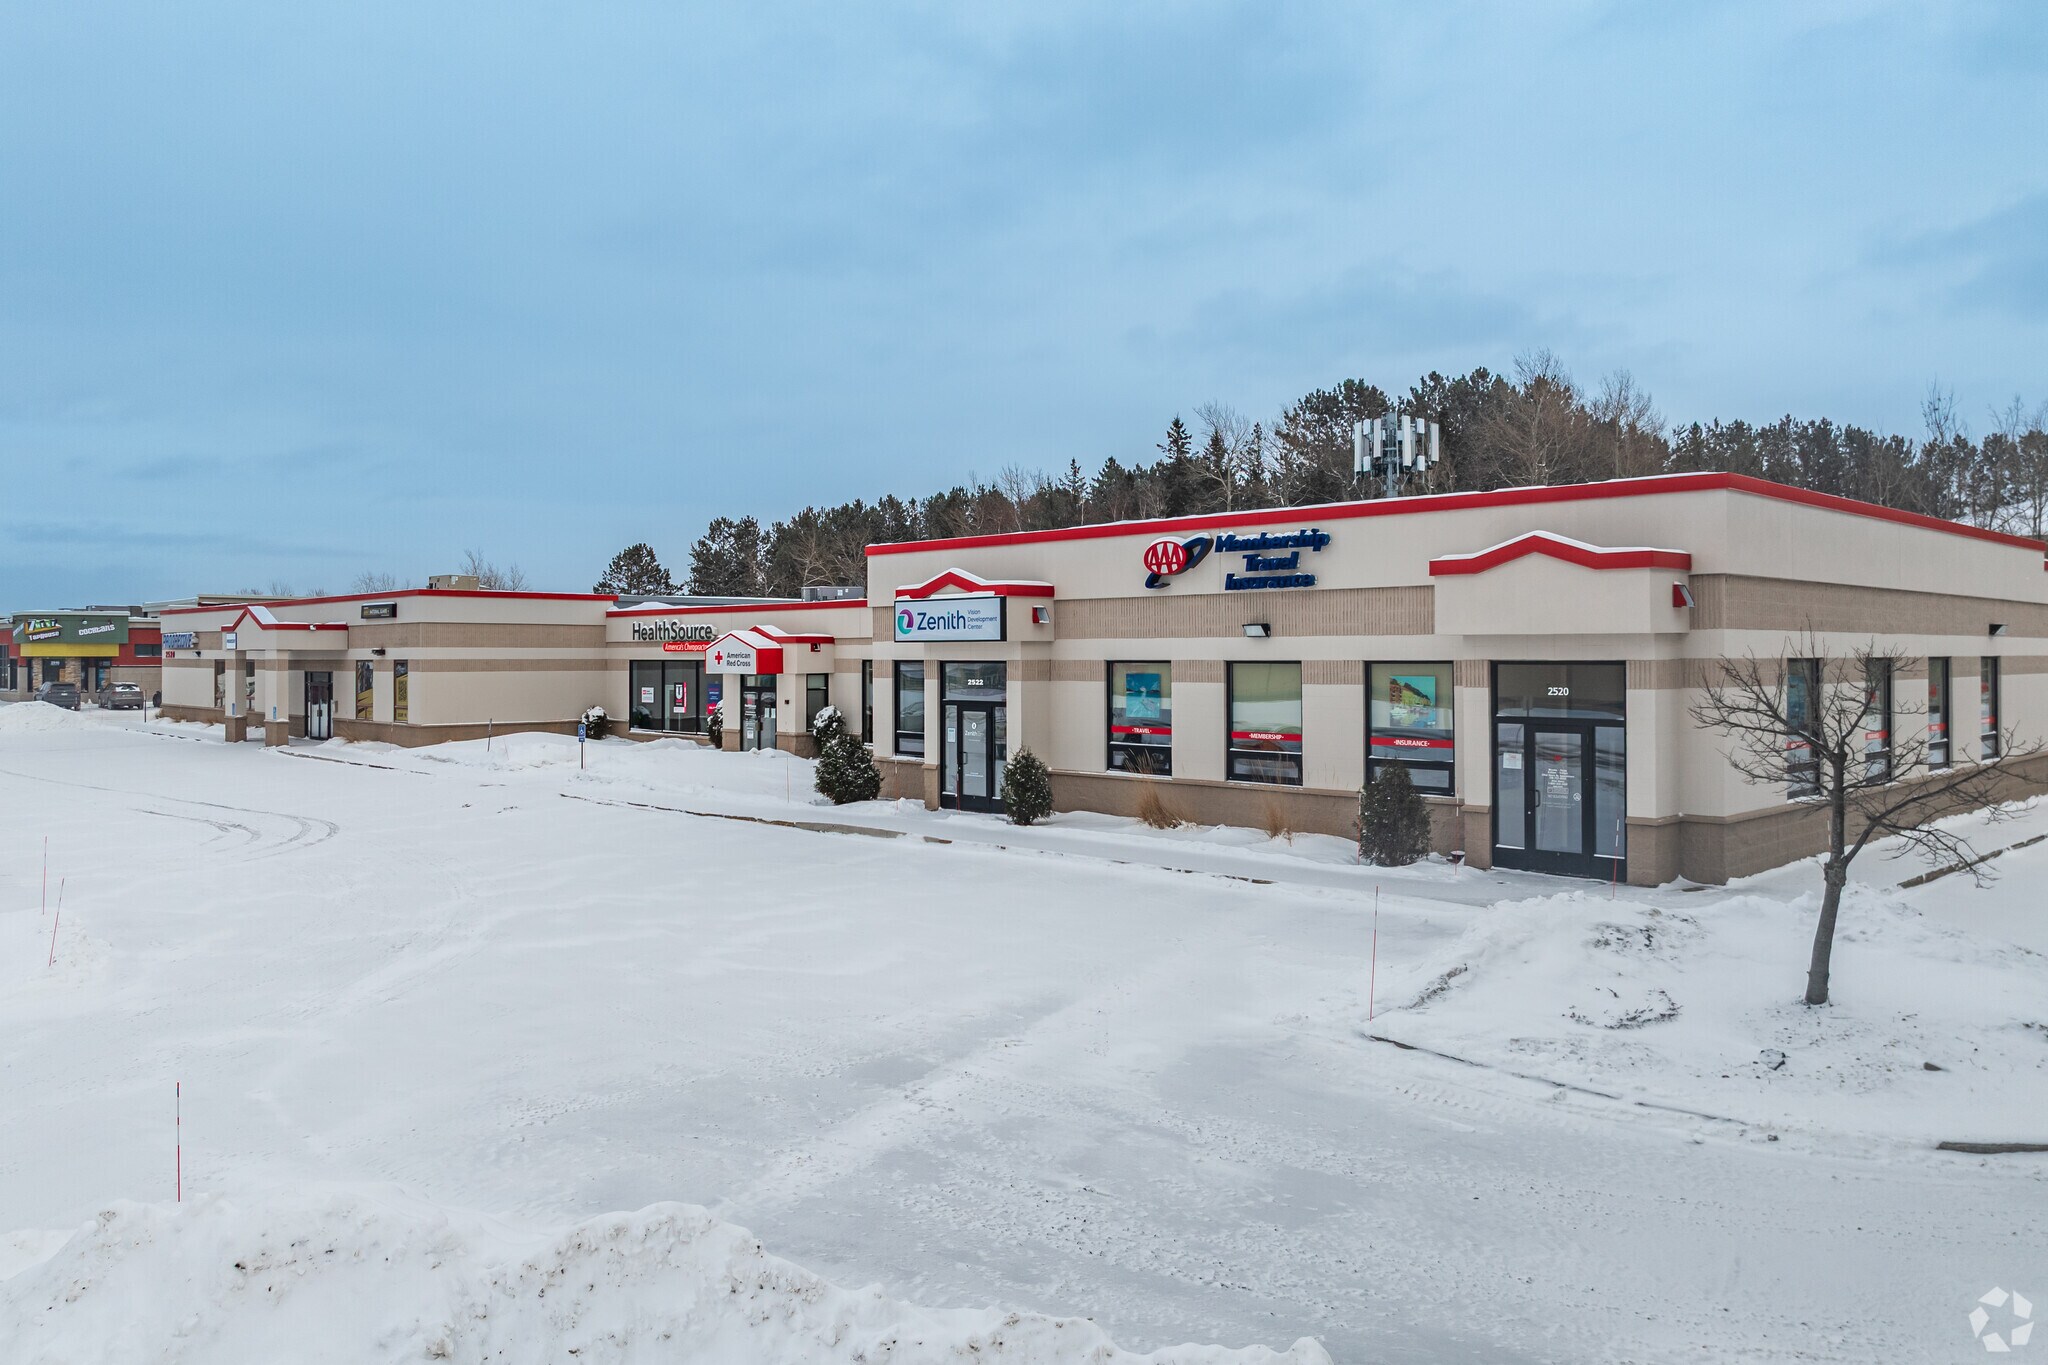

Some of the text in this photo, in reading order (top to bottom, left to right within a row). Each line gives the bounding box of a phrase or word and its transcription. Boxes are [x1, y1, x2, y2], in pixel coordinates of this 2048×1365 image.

[1214, 528, 1331, 553] Membership
[1146, 541, 1186, 574] AAA
[1242, 551, 1299, 572] Travel
[1225, 573, 1317, 591] Insurance
[632, 620, 713, 641] HealthSource
[917, 610, 966, 631] Zenith
[664, 643, 707, 652] America's Chiropracto
[726, 651, 751, 659] American
[1547, 687, 1570, 696] 2520
